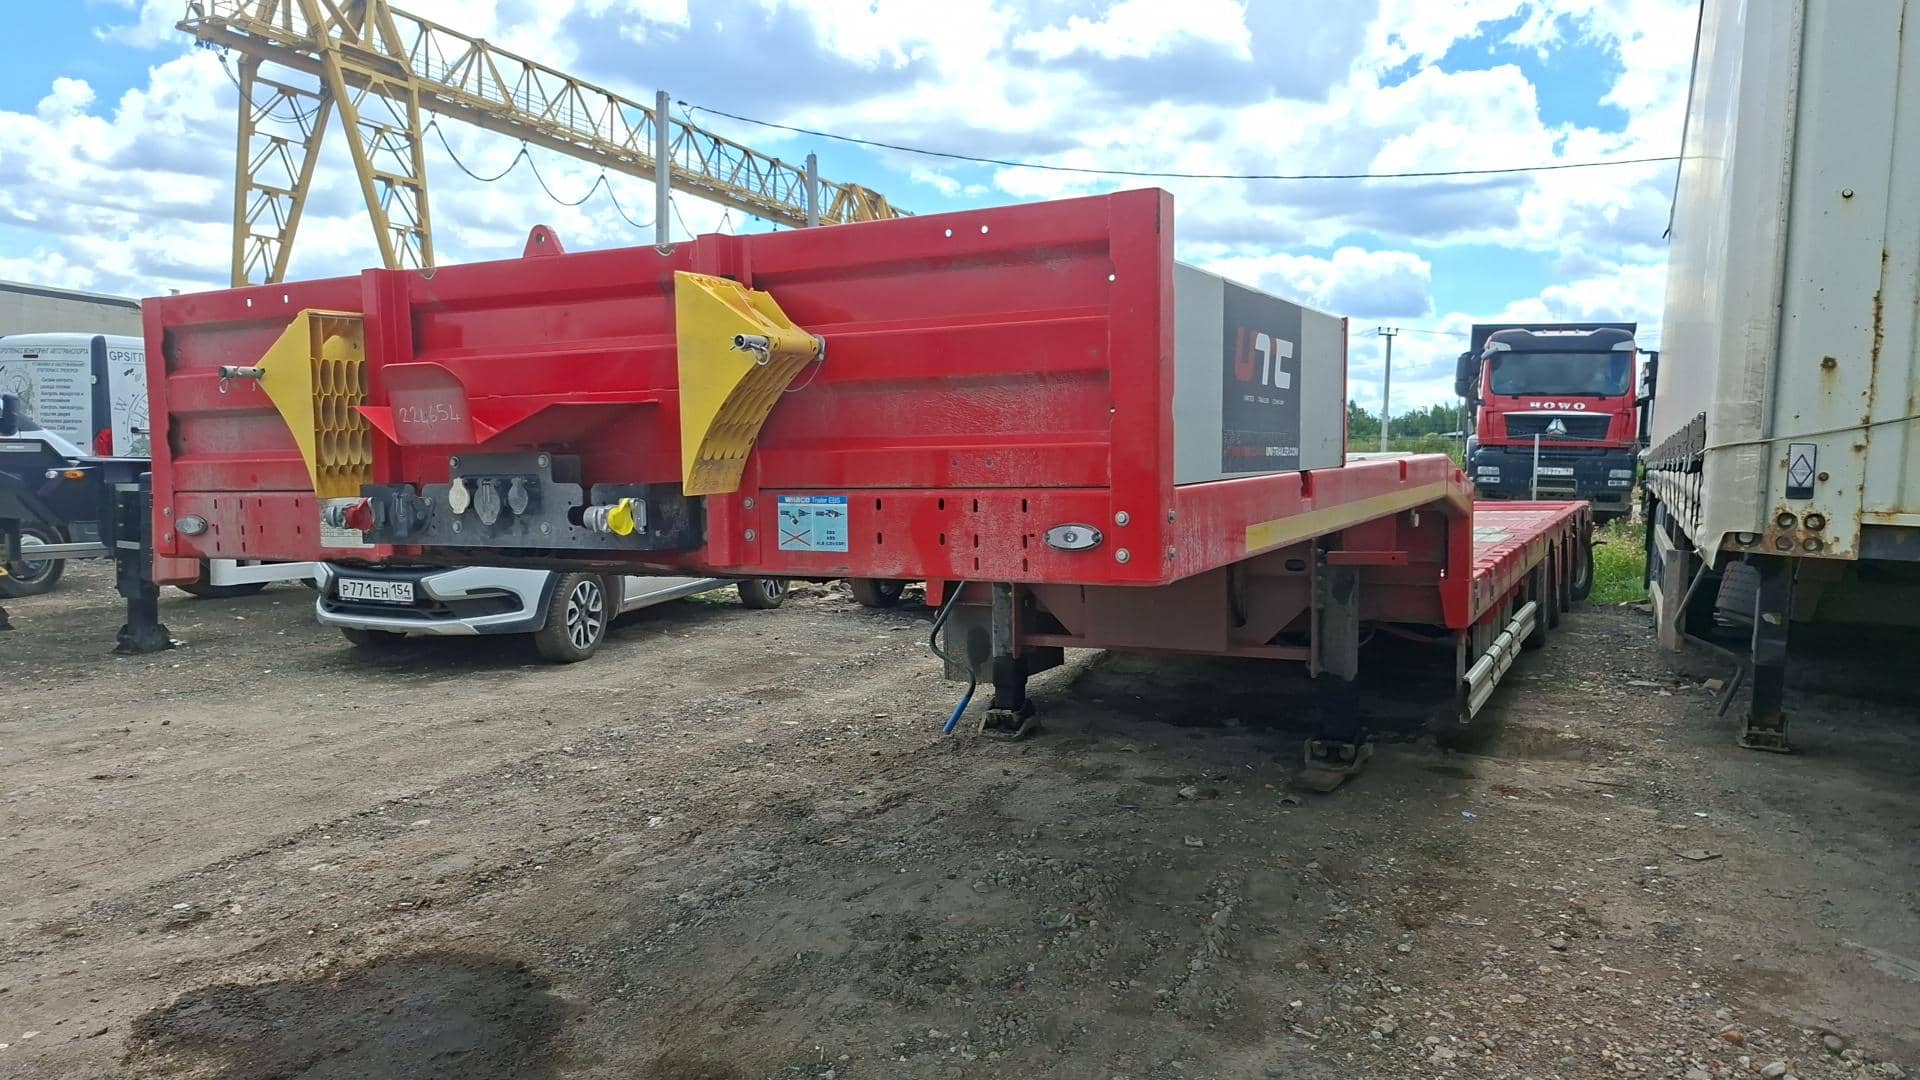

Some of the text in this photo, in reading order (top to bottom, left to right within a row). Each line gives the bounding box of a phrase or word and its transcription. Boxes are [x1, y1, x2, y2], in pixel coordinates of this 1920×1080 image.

[1235, 326, 1294, 389] UTC
[1529, 401, 1586, 410] HOWO
[391, 584, 411, 596] 154
